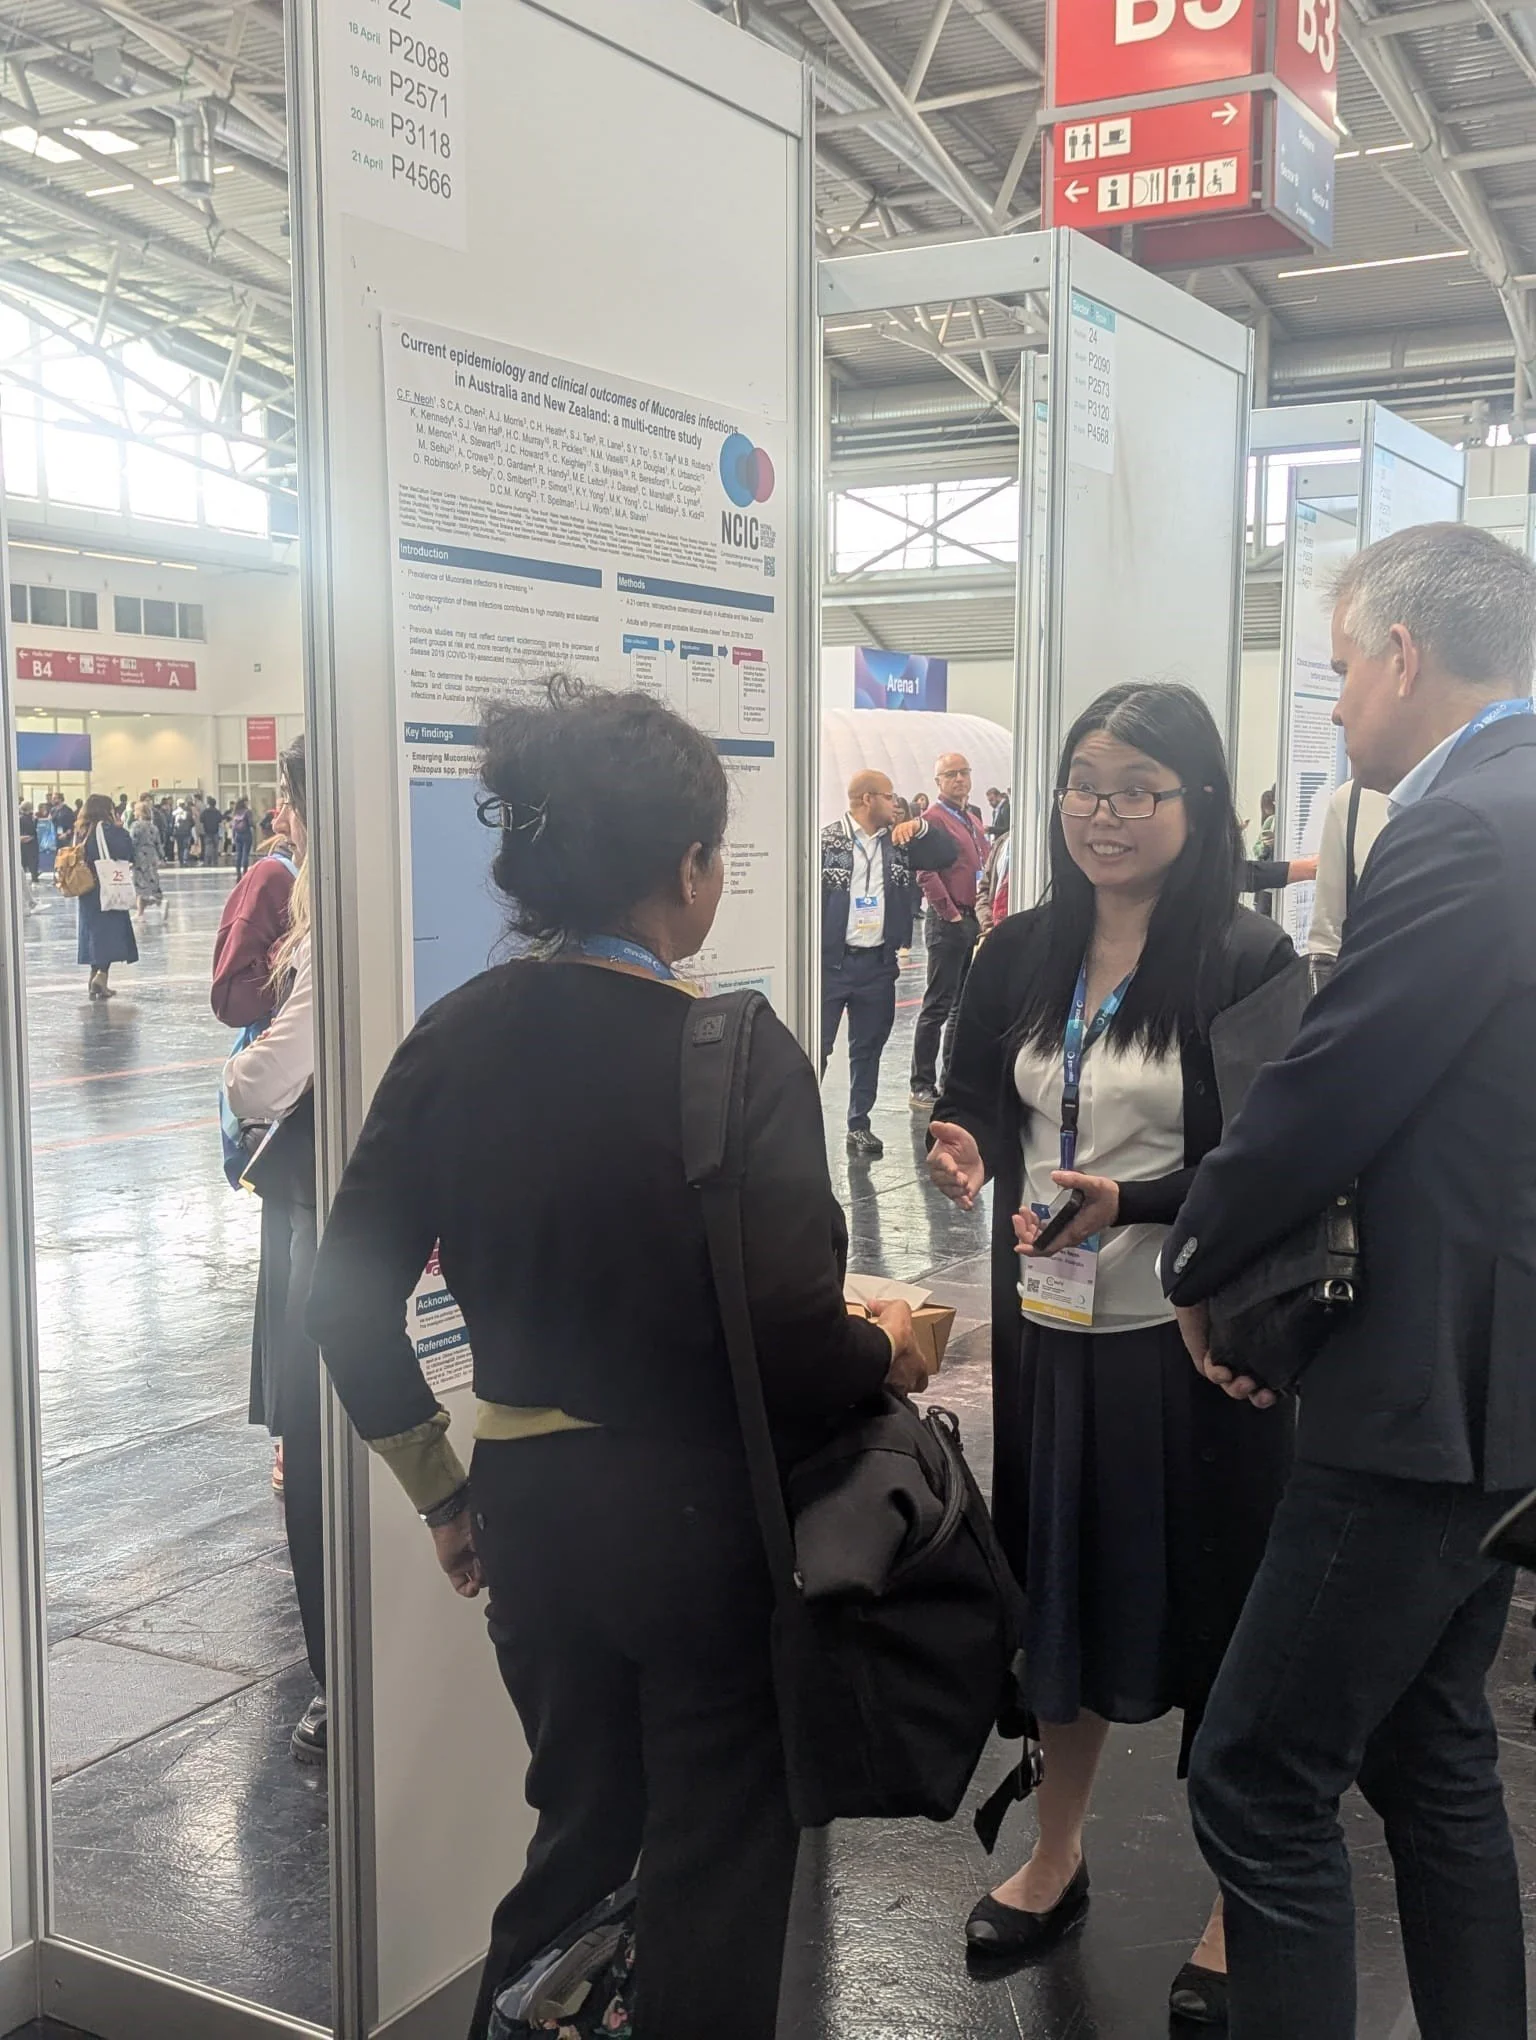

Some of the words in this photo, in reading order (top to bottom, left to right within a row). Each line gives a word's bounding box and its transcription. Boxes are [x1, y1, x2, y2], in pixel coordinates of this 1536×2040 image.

[1298, 0, 1336, 74] B3
[349, 22, 358, 34] 18
[360, 27, 381, 45] April
[389, 28, 449, 78] P2088
[350, 64, 360, 77] 19
[361, 69, 382, 87] April
[390, 70, 448, 119] P2571
[351, 107, 362, 121] 20
[365, 113, 384, 129] April
[391, 112, 451, 159] P3118
[352, 150, 362, 163] 21
[363, 155, 383, 171] April
[392, 154, 451, 199] P4566
[1088, 327, 1097, 344] 24
[1088, 352, 1111, 375] P2090
[401, 332, 447, 359] Current
[450, 349, 526, 383] epidemiology
[528, 369, 549, 386] and
[551, 371, 589, 396] clinical
[590, 387, 637, 409] outcomes
[639, 398, 650, 412] of
[651, 400, 696, 425] Mucorales
[698, 413, 739, 434] infections
[1088, 376, 1110, 398] P2573
[455, 370, 465, 388] in
[468, 374, 518, 401] Australia
[521, 392, 541, 407] and
[544, 393, 566, 413] New
[568, 400, 610, 424] Zealand:
[613, 415, 619, 426] a
[621, 417, 676, 440] multi-centre
[678, 431, 702, 450] study
[1087, 400, 1110, 421] P3120
[1087, 424, 1109, 445] P4568
[721, 510, 759, 550] NCIC
[400, 544, 448, 560] Introduction
[408, 569, 437, 580] Prevalence
[618, 576, 645, 589] Methods
[32, 660, 52, 678] B4
[169, 671, 180, 686] A
[887, 673, 913, 694] Arena
[915, 677, 919, 694] 1
[405, 727, 419, 740] Key
[421, 727, 453, 741] findings
[412, 752, 442, 763] Emerging
[444, 753, 475, 762] Mucorales
[412, 765, 441, 775] Rhizopus
[418, 1332, 462, 1354] References
